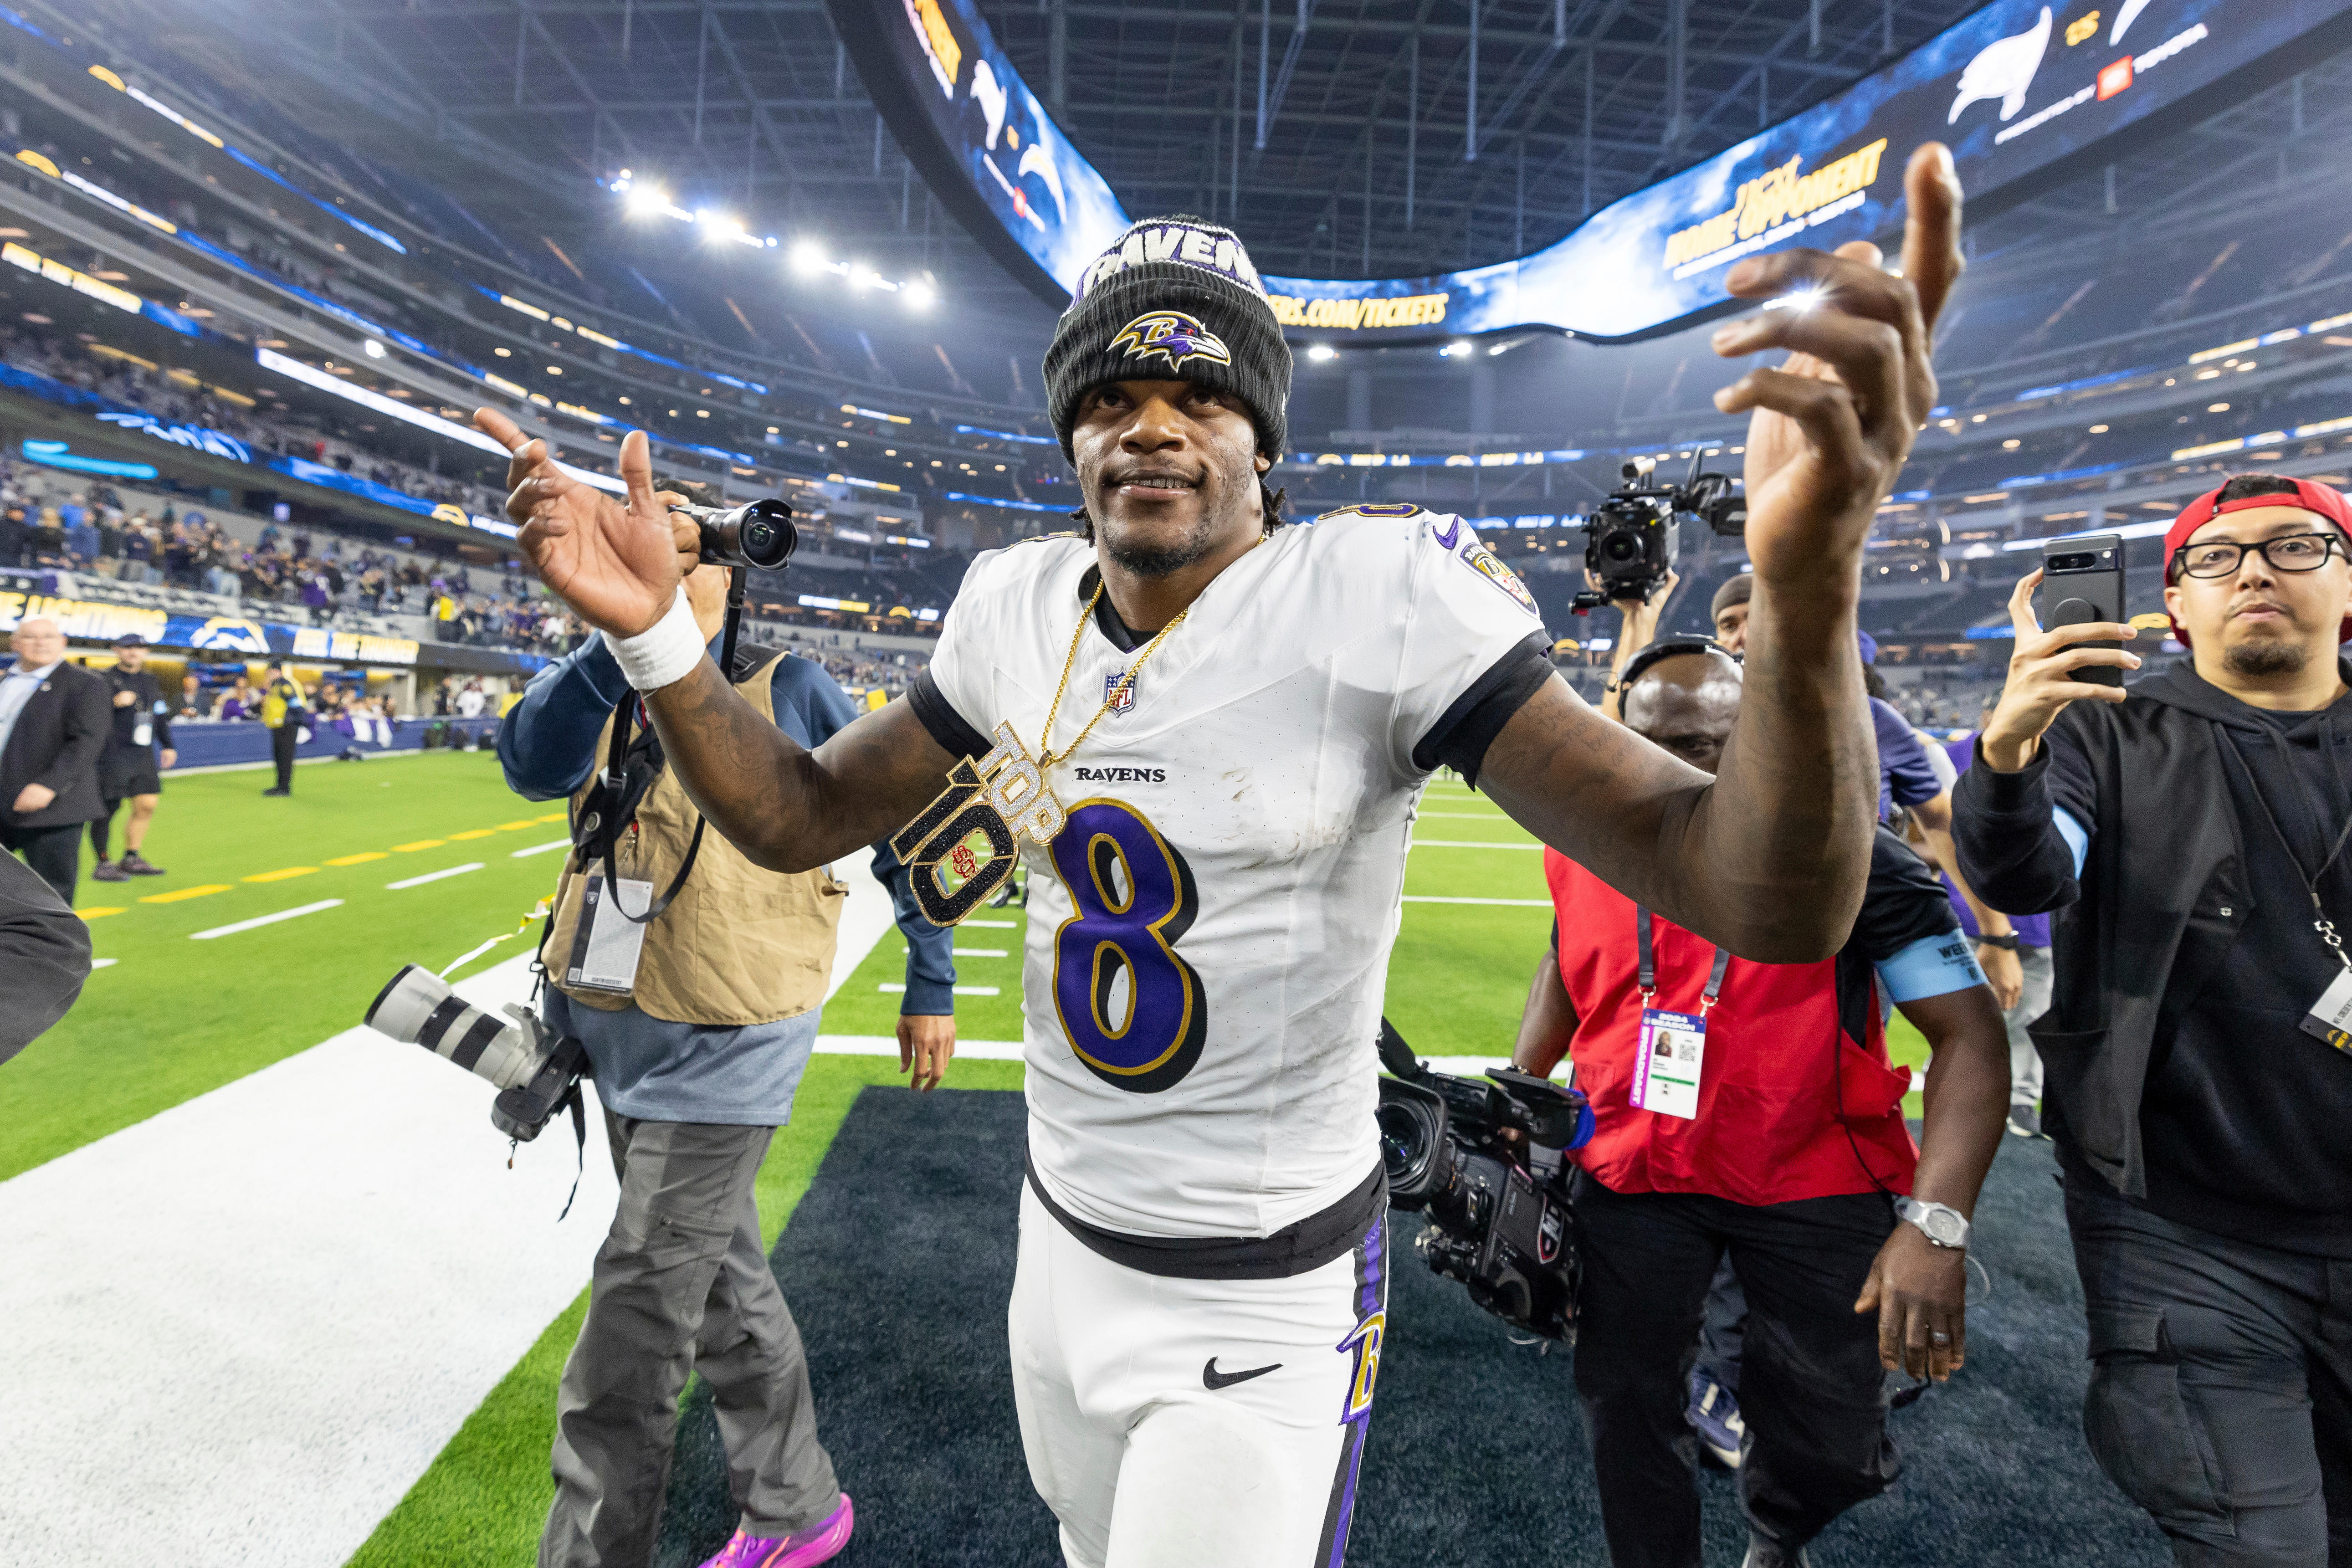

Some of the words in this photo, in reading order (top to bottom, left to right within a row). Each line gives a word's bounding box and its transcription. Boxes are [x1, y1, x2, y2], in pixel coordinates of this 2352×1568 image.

[1737, 138, 1888, 241] OPPONENT
[976, 718, 1067, 846] TOP
[1074, 767, 1166, 783] RAVENS
[889, 754, 1020, 927] 10
[1048, 797, 1208, 1094] 8
[1650, 1018, 1696, 1032] SEASON
[1658, 1013, 1689, 1023] 2024
[1632, 1026, 1650, 1105] BROADCAST
